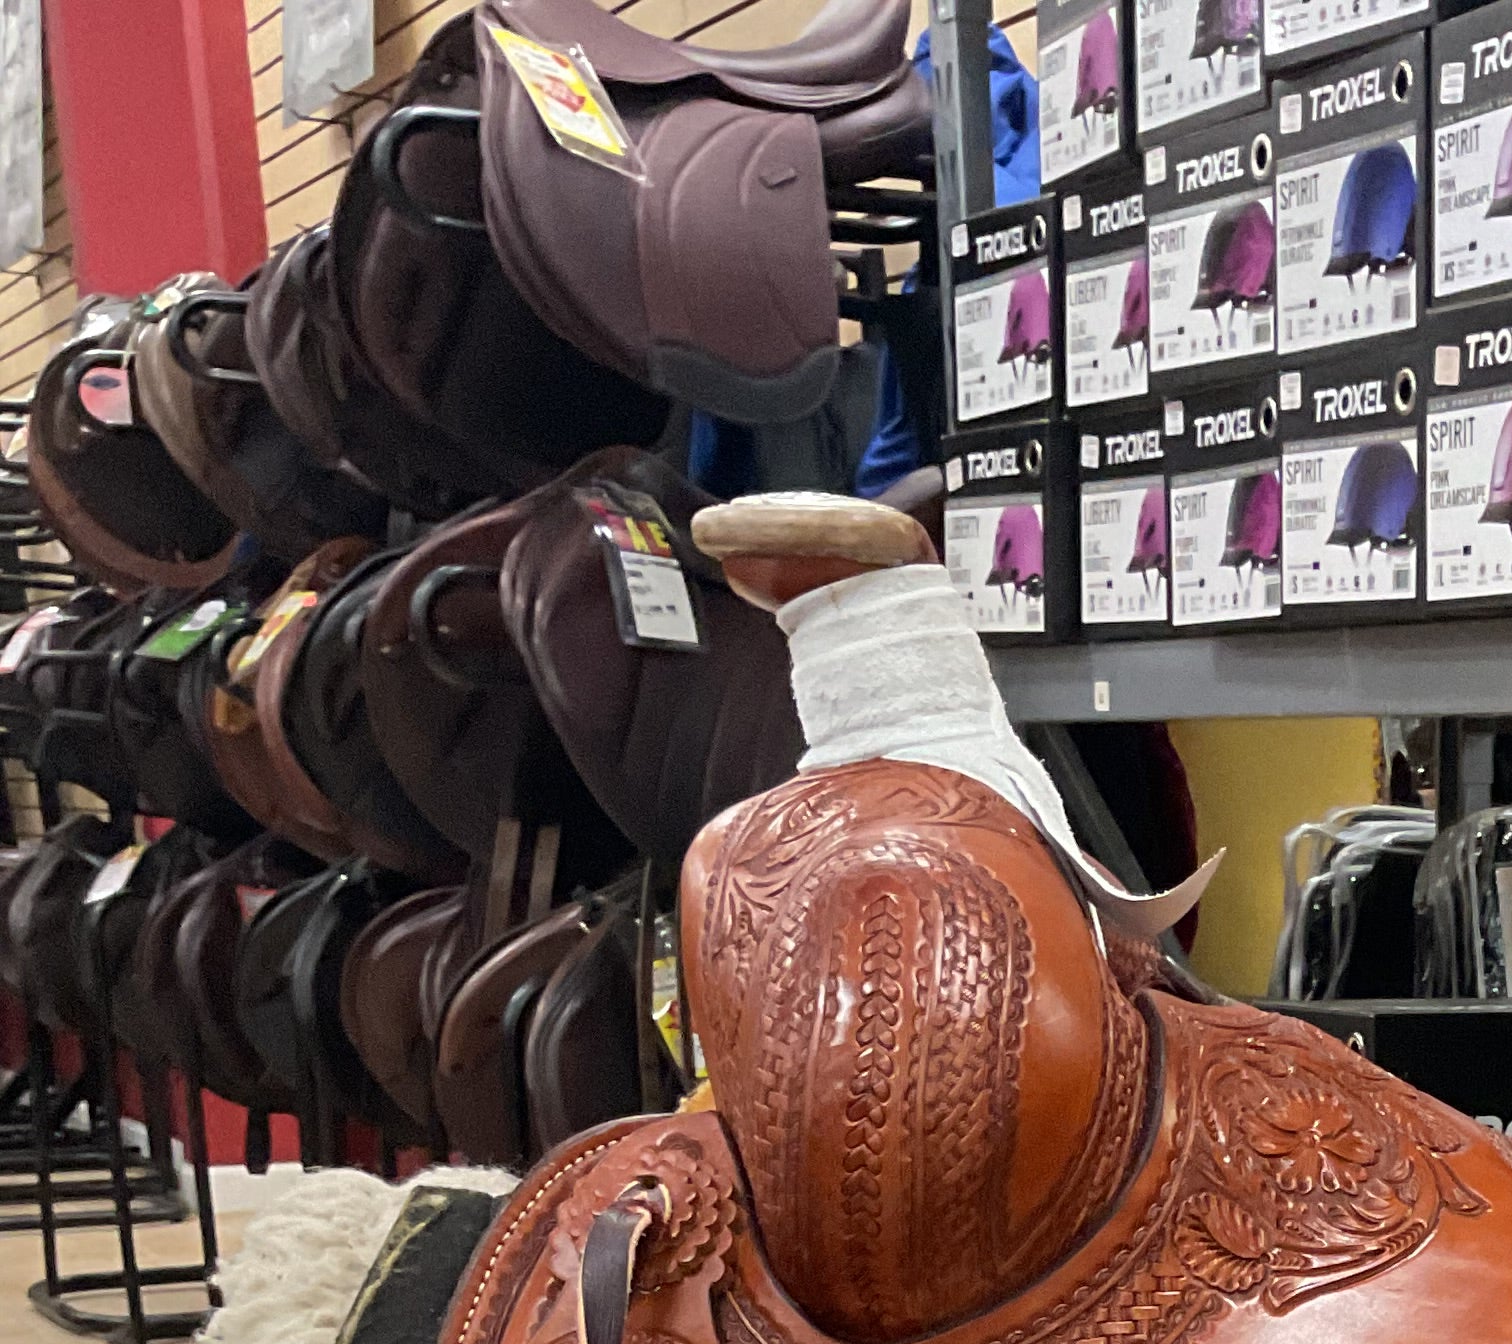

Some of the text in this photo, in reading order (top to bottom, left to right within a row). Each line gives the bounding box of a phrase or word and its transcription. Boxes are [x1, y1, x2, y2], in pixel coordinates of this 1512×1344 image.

[1310, 68, 1386, 122] TROXEL
[1438, 124, 1481, 163] SPIRIT
[1176, 146, 1245, 193] TROXEL
[1279, 172, 1320, 211] SPIRIT
[1090, 194, 1146, 237] TROXEL
[975, 225, 1028, 264] TROXEL
[1151, 225, 1187, 256] SPIRIT
[1314, 381, 1387, 423] TROXEL
[1194, 408, 1256, 447] TROXEL
[1430, 417, 1475, 452] SPIRIT
[967, 447, 1021, 480] TROXEL
[1104, 430, 1165, 465] TROXEL
[1286, 457, 1324, 486] SPIRIT
[1174, 491, 1208, 523] SPIRIT
